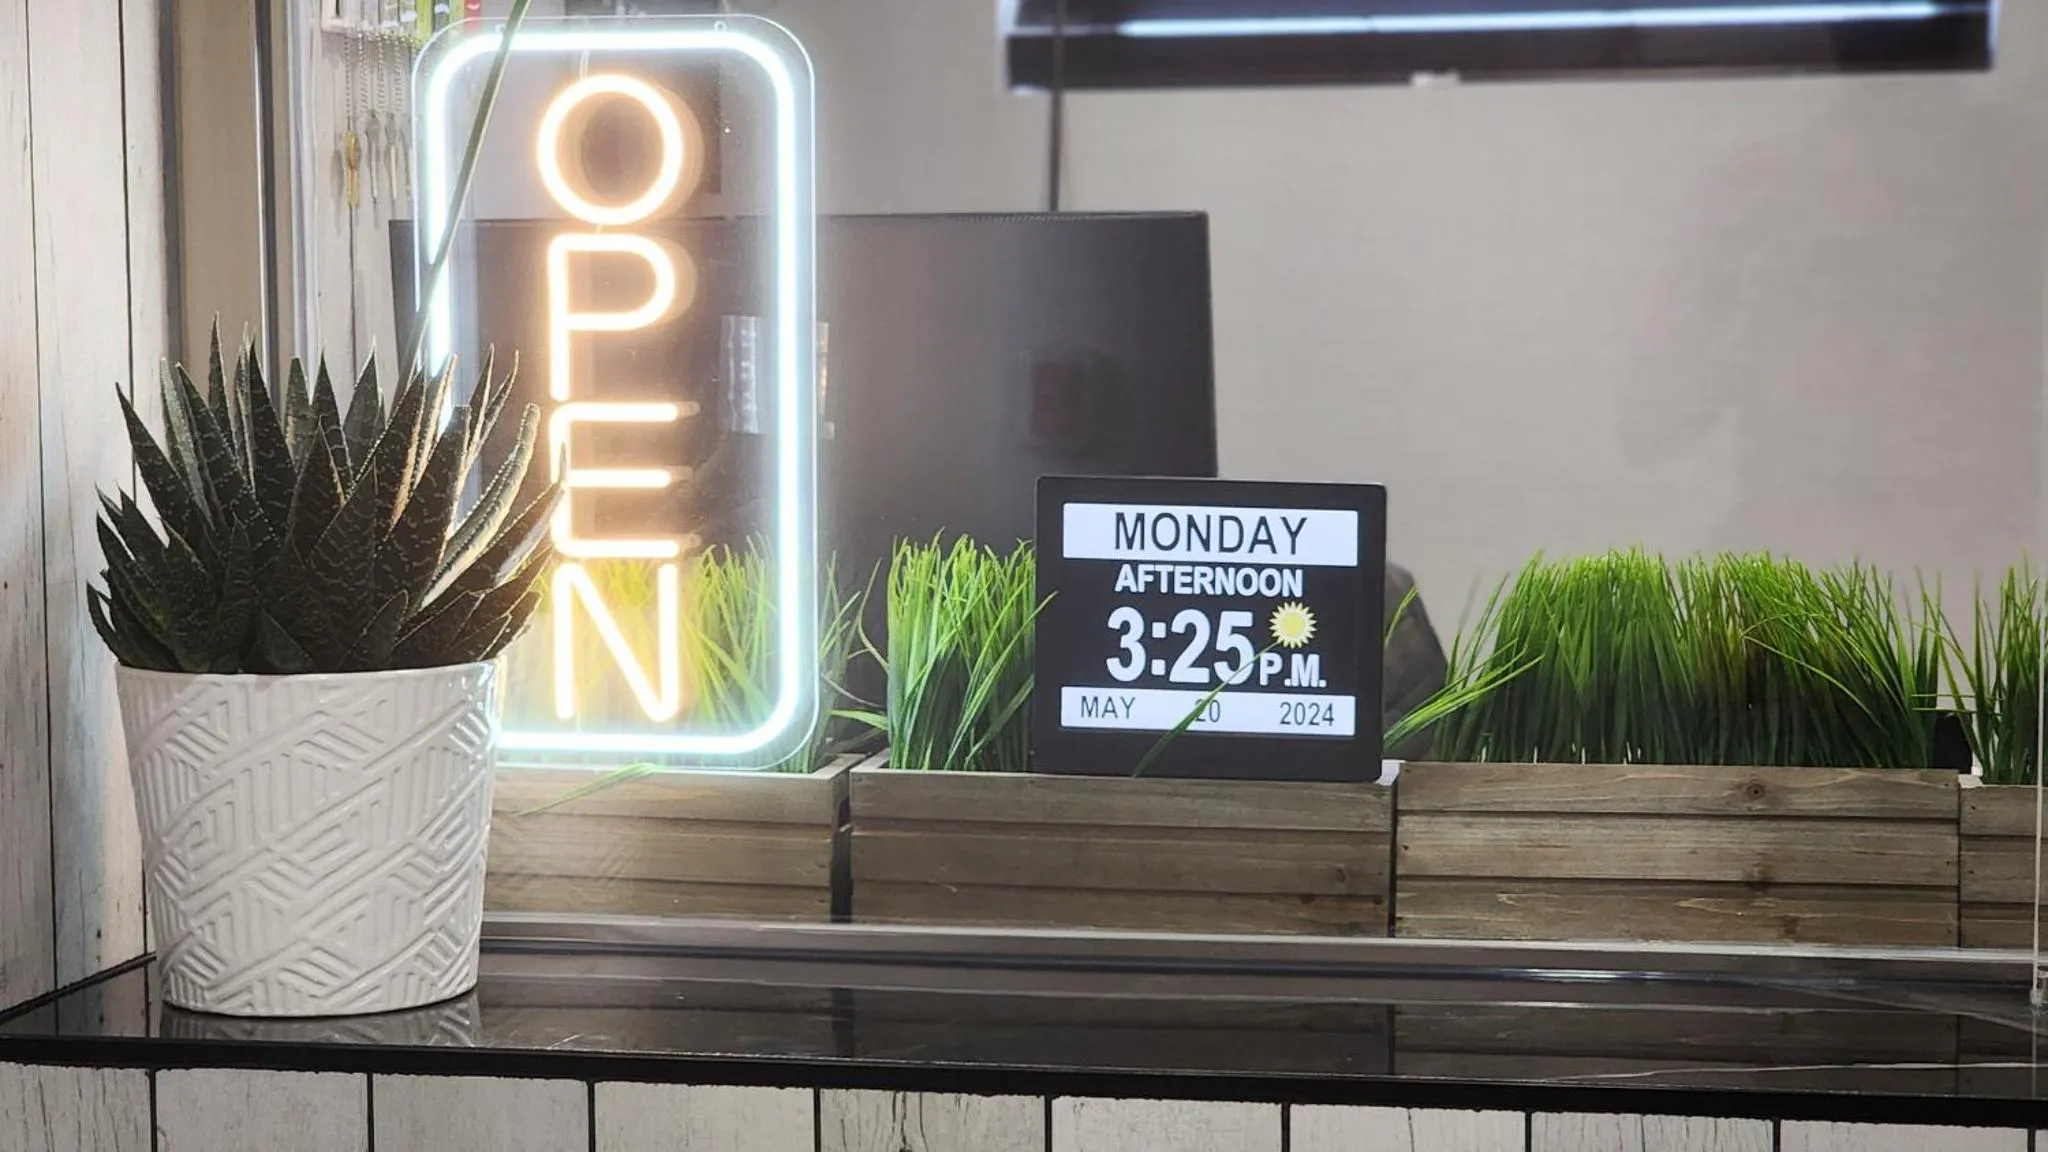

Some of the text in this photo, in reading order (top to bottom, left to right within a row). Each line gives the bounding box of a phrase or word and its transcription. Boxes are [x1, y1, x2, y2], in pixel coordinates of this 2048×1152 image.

[536, 73, 686, 723] OPEN
[1115, 511, 1308, 555] MONDAY
[1114, 563, 1303, 597] AFTERNOON
[1106, 606, 1327, 688] 3:25 P.M.
[1080, 695, 1136, 719] MAY
[1279, 702, 1335, 727] 2024
